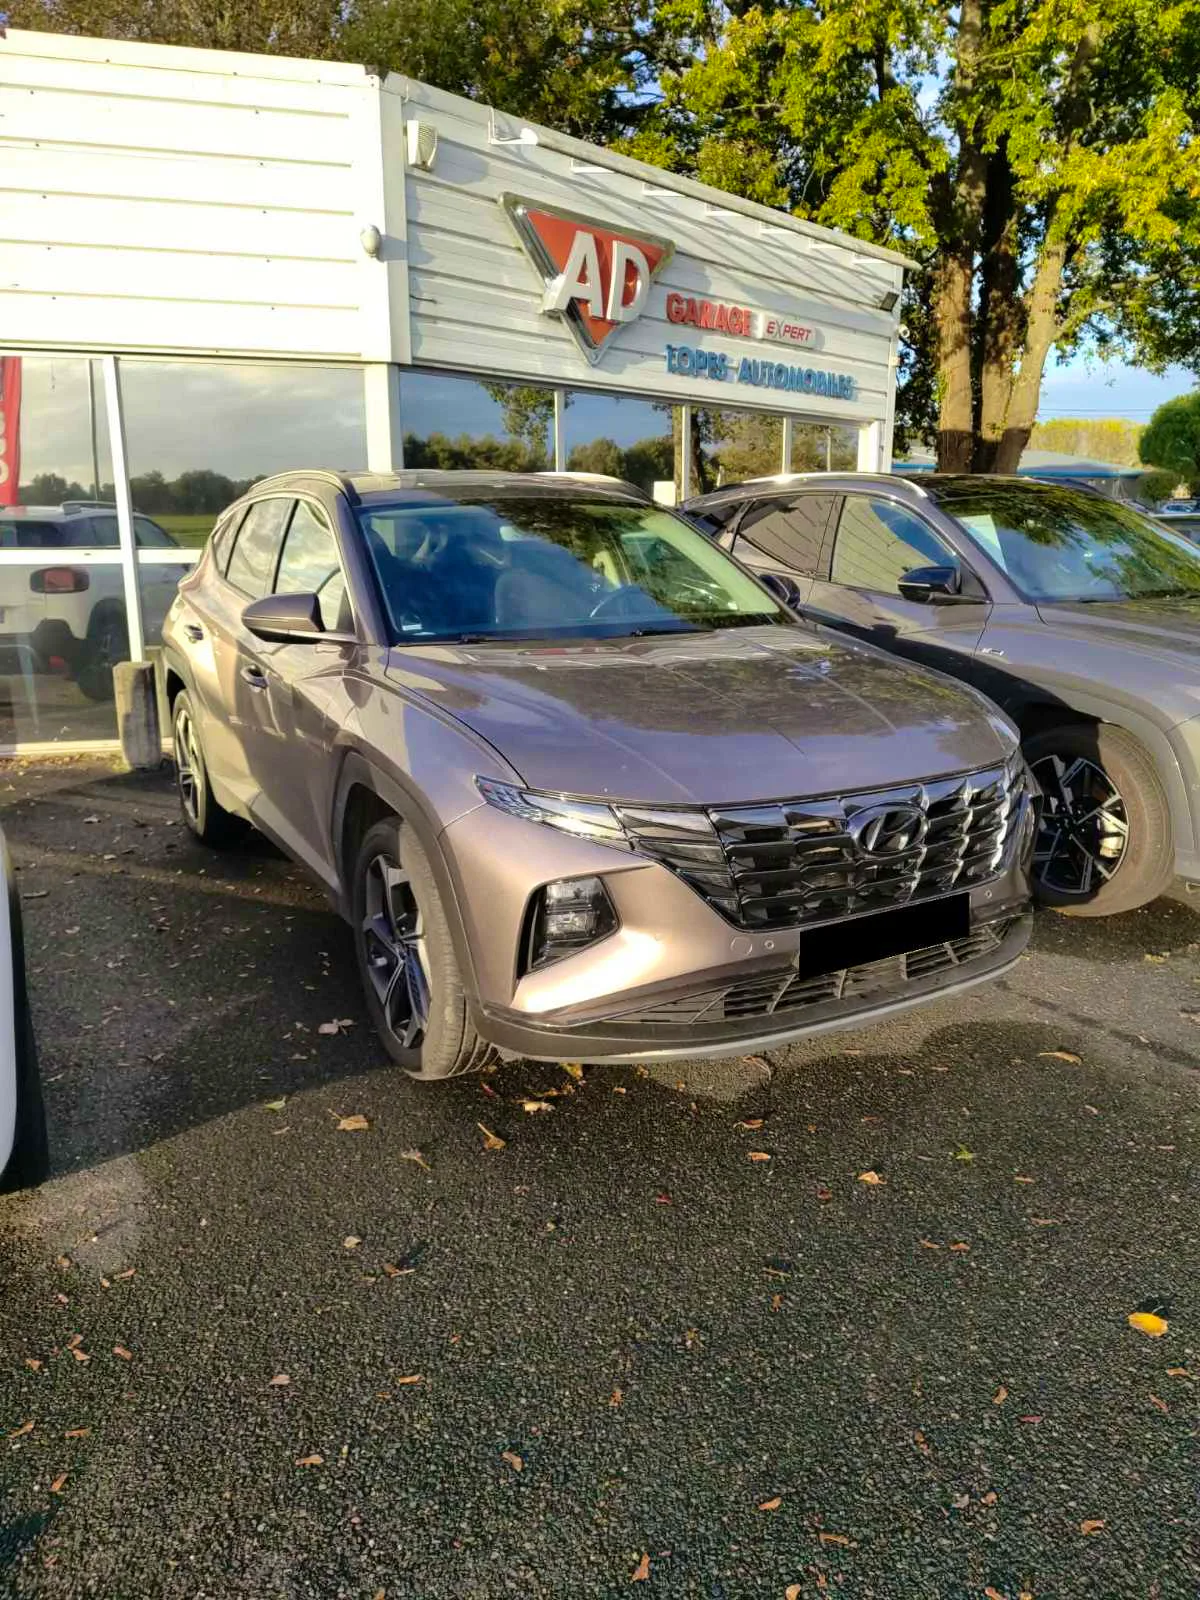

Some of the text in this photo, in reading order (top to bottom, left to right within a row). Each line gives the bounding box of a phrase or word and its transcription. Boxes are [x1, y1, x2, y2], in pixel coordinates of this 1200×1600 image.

[539, 230, 650, 322] AD
[666, 292, 752, 337] GARAGE
[737, 357, 855, 401] AUTOMOBILES
